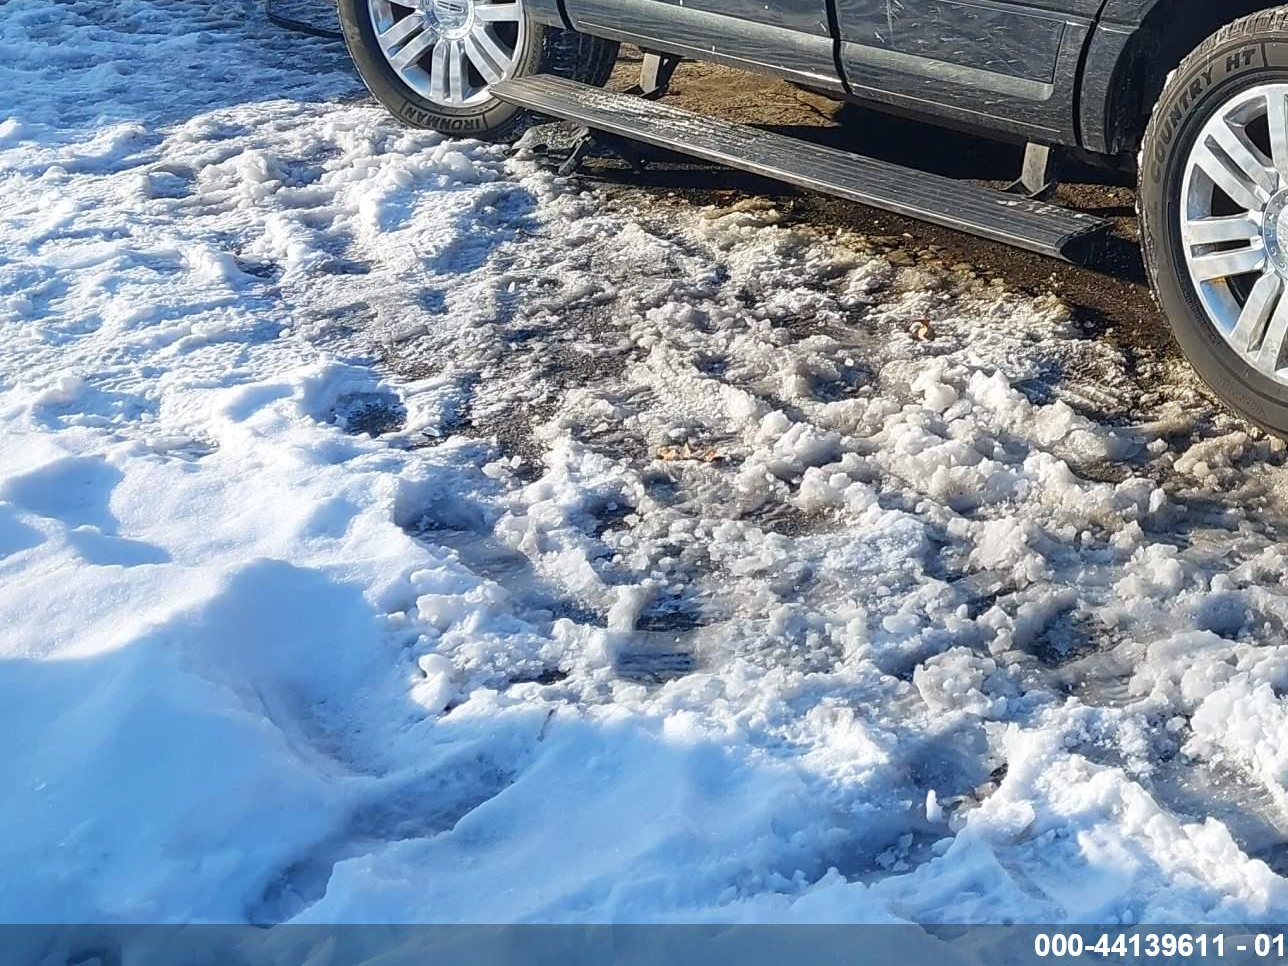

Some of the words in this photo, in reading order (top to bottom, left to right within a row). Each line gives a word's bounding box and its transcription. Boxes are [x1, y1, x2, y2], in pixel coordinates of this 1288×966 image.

[405, 106, 481, 131] IRONMAN
[1151, 64, 1213, 183] COUNTRY
[1225, 48, 1256, 73] HT
